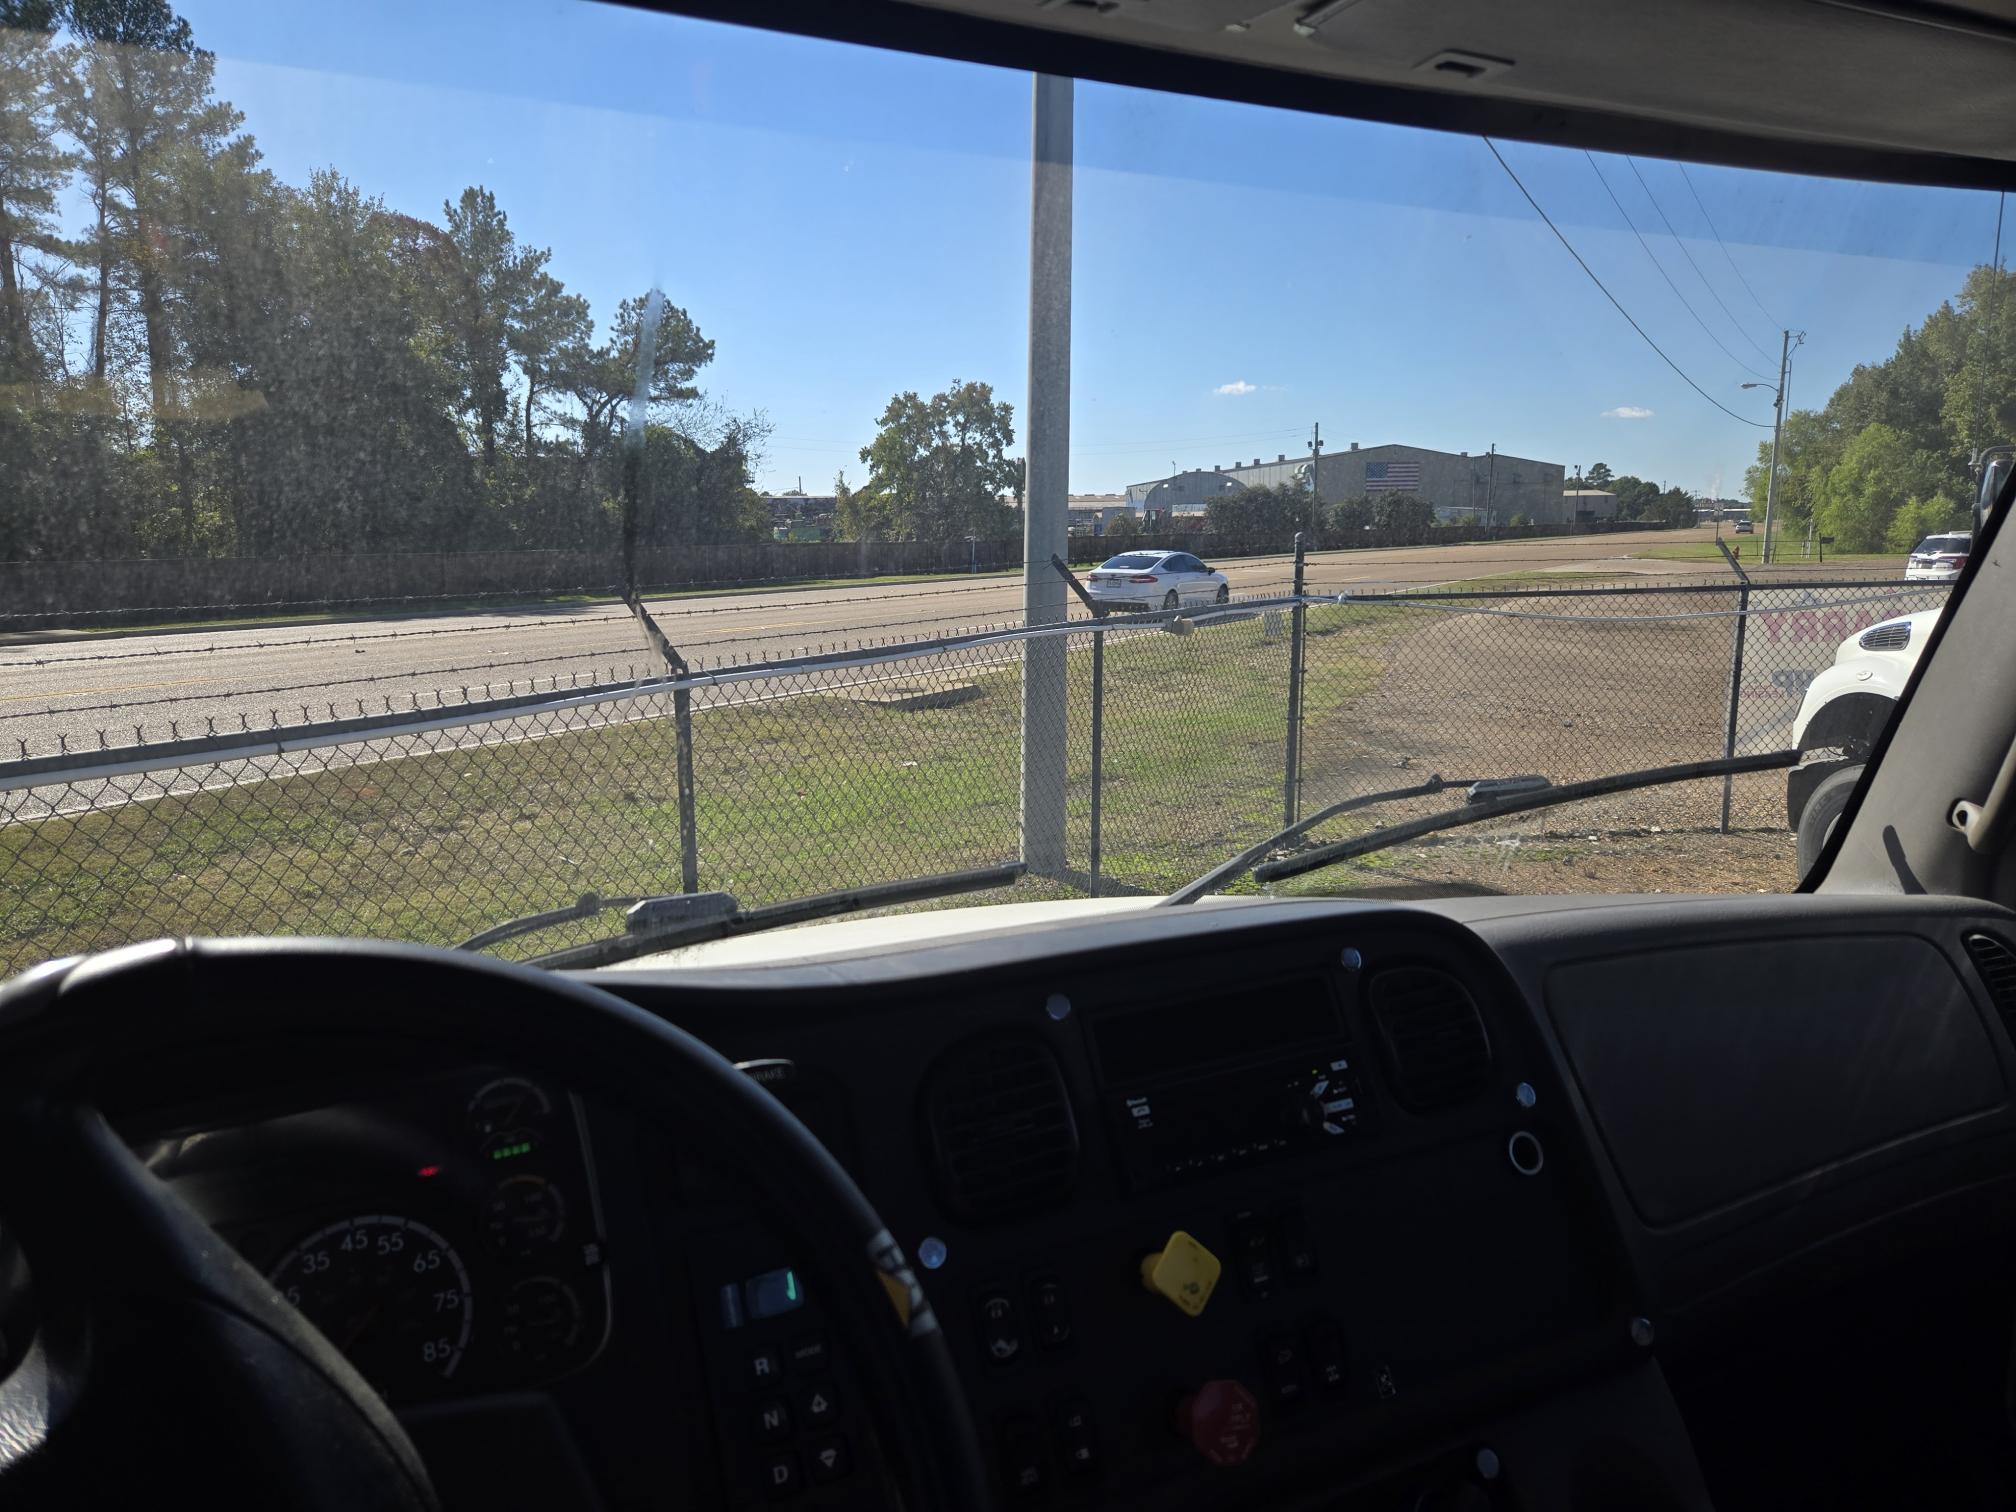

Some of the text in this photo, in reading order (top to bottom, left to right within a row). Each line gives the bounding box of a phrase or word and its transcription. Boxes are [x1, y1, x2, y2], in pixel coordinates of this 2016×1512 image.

[340, 1229, 368, 1252] 45
[377, 1232, 404, 1255] 55
[303, 1251, 330, 1274] 35
[413, 1250, 440, 1273] 65
[285, 1285, 300, 1305] 5
[433, 1289, 459, 1312] 75
[423, 1338, 451, 1362] 85
[753, 1356, 770, 1376] R
[763, 1409, 779, 1430] N
[772, 1465, 789, 1485] D
